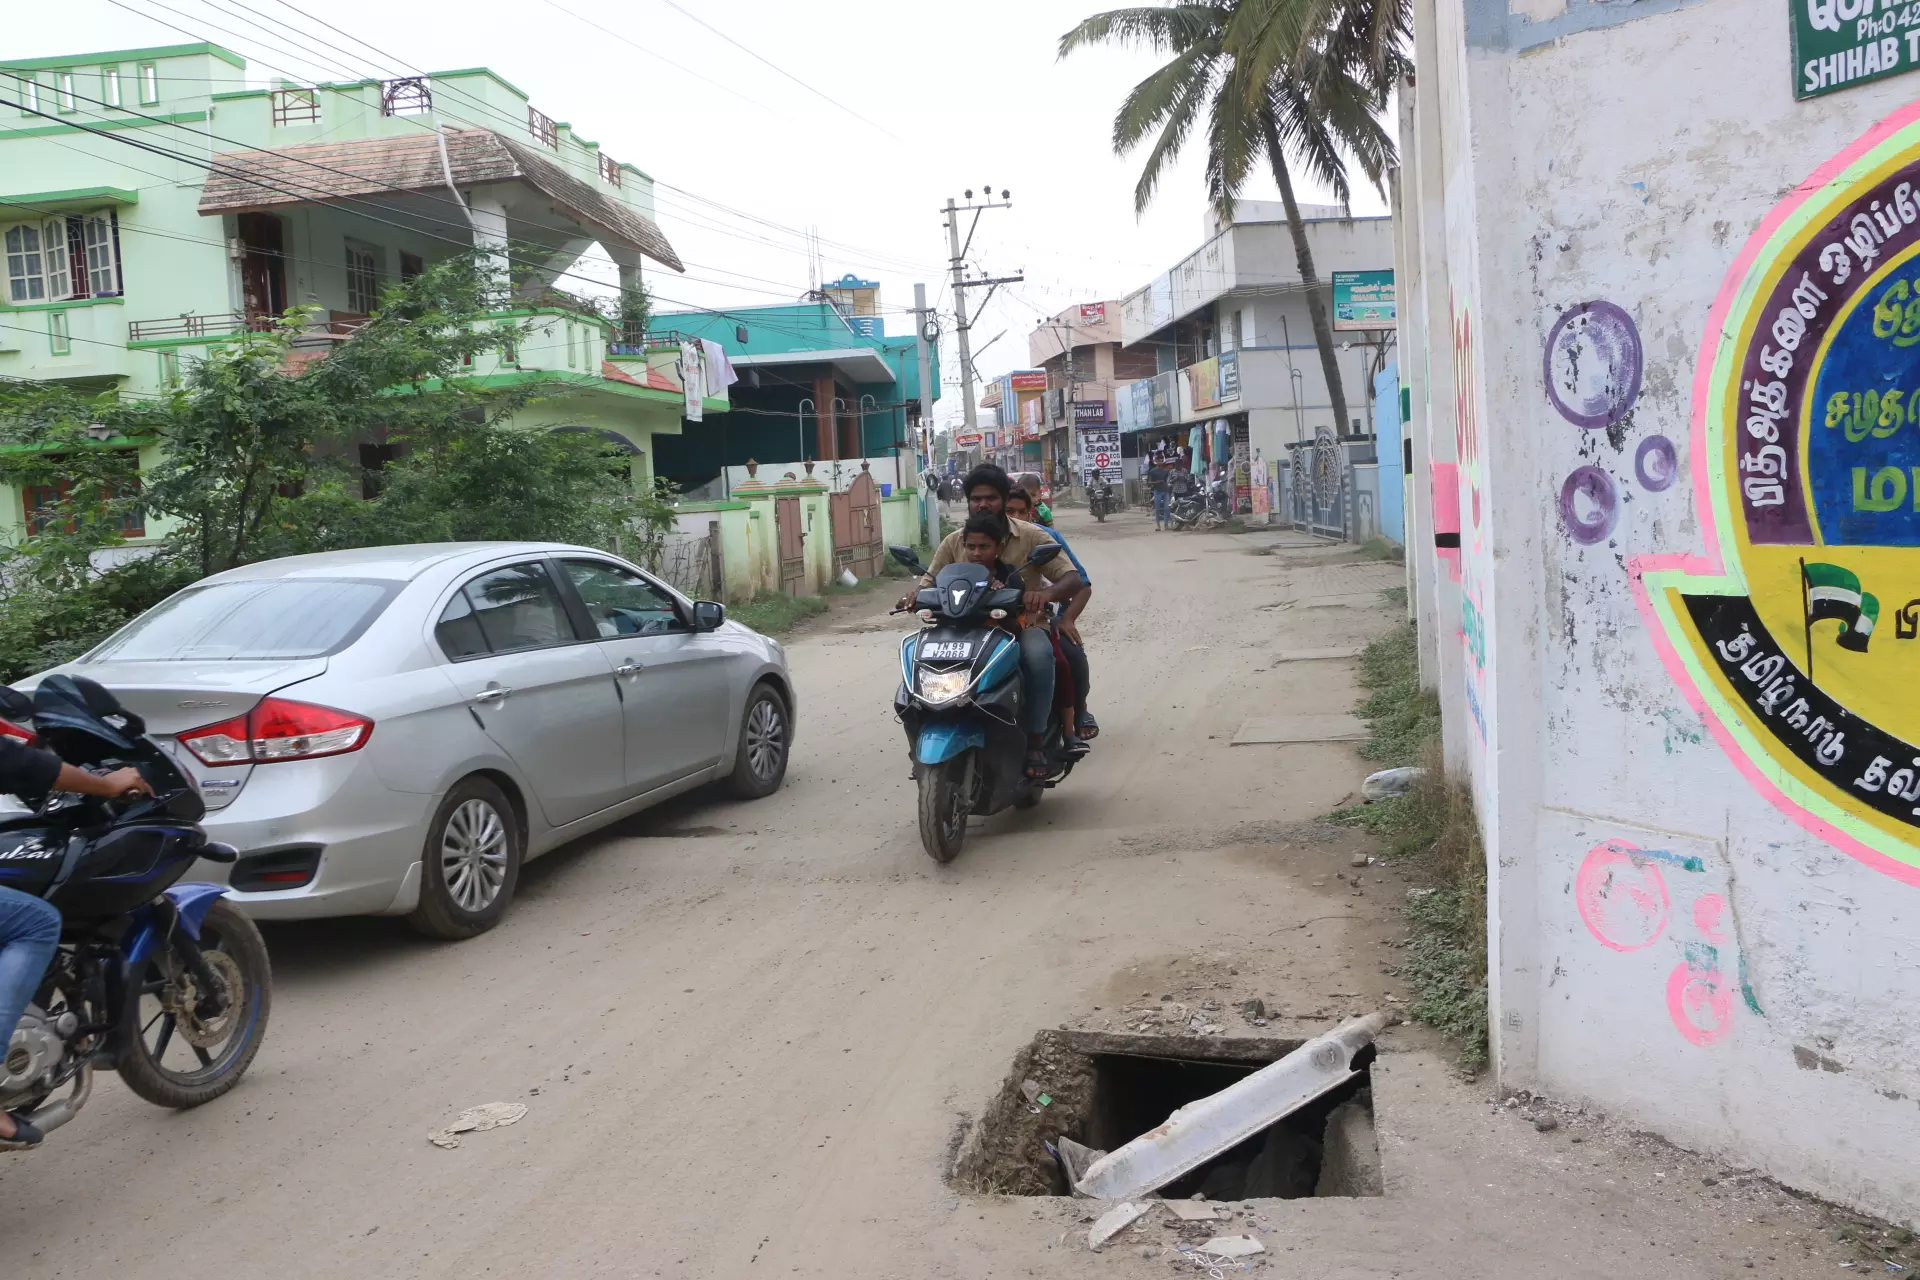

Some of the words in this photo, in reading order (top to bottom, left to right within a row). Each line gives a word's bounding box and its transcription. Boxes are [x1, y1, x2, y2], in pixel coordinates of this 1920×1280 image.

[1804, 37, 1899, 92] SHIHAB
[1092, 408, 1104, 417] LAB
[1084, 434, 1119, 443] LAB
[1085, 441, 1120, 453] லேப்
[1716, 631, 1845, 766] தமிழ்நாடு
